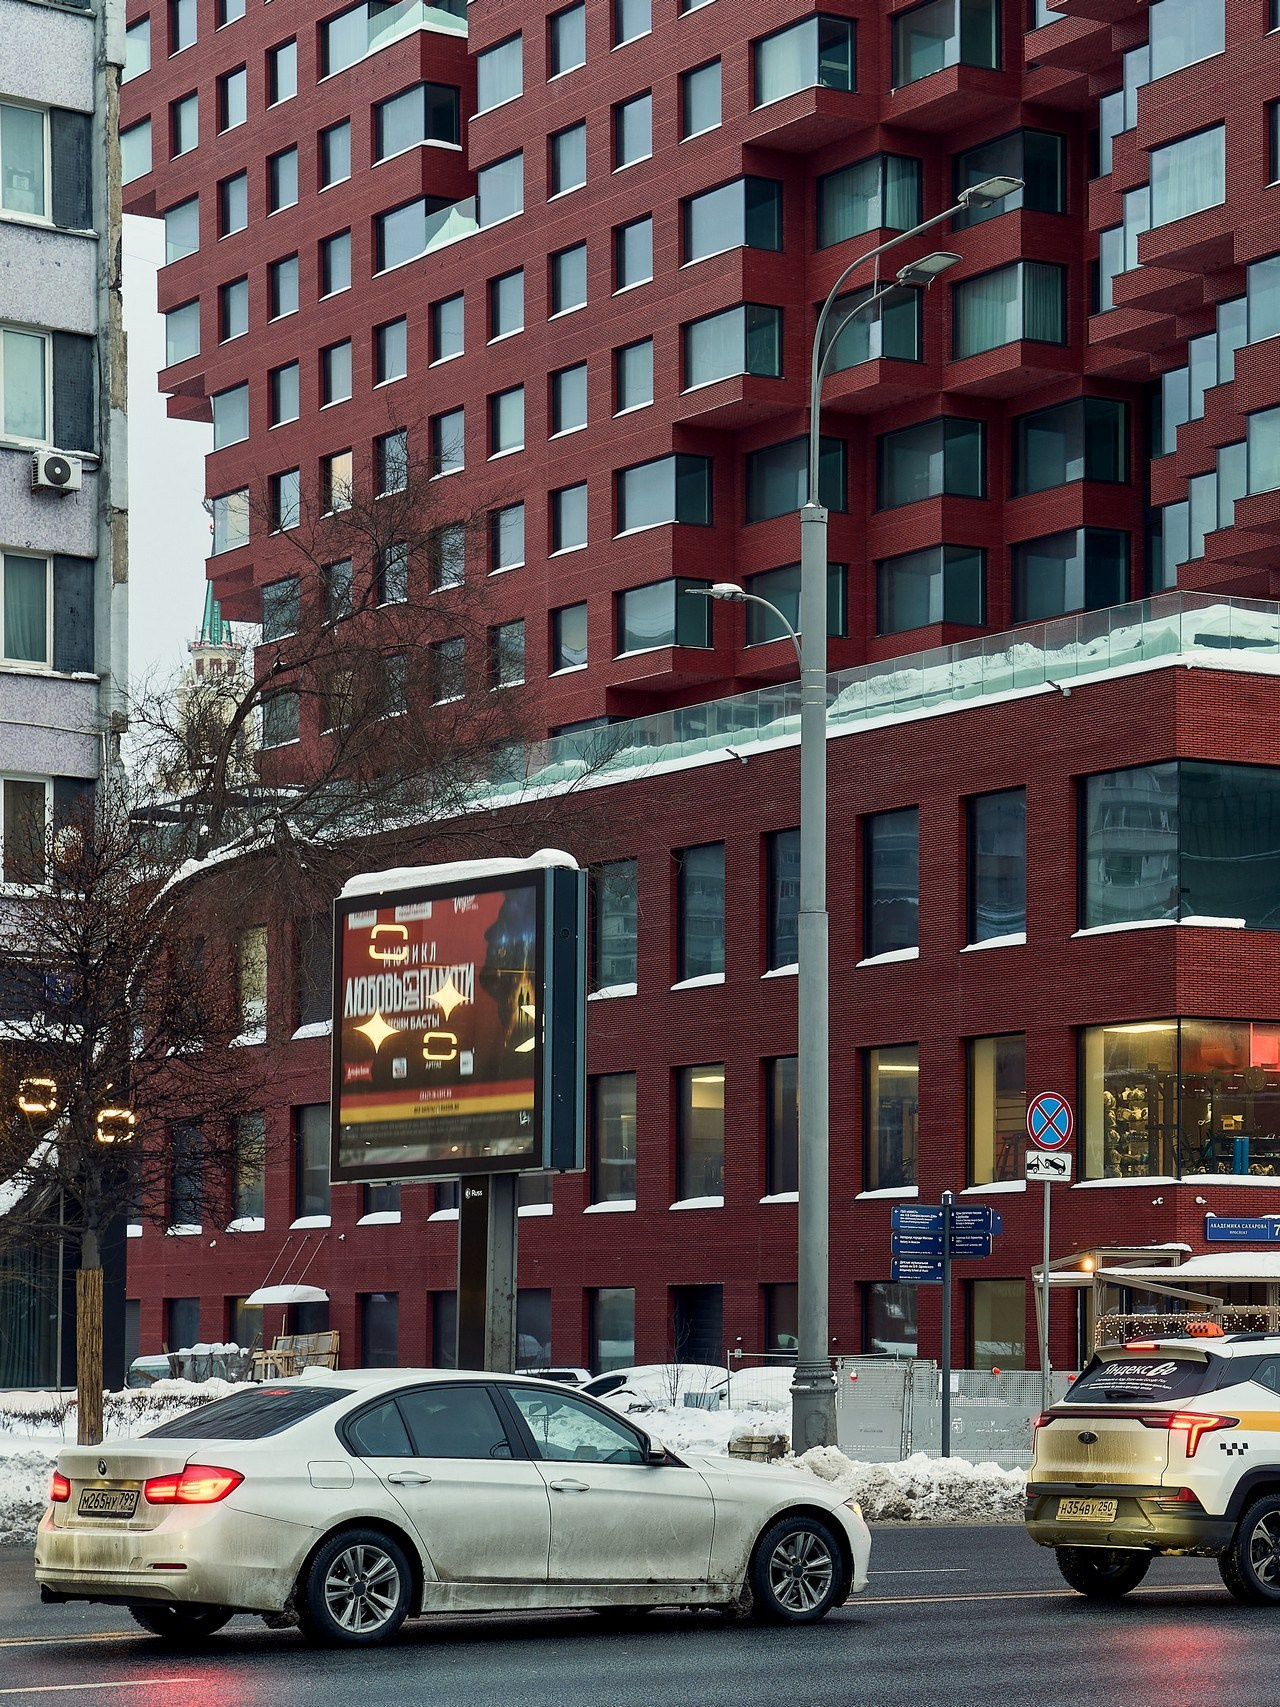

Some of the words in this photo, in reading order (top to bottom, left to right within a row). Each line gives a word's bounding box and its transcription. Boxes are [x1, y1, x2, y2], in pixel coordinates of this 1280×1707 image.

[344, 972, 403, 1018] ЛЮБОВЬ
[410, 1013, 440, 1031] БАСТЫ
[1273, 1224, 1280, 1236] 7
[1101, 1363, 1153, 1376] Яндекс
[1146, 1361, 1178, 1377] Go
[81, 1492, 118, 1510] М265НУ
[118, 1492, 135, 1507] 799
[1060, 1501, 1097, 1515] Н354ВУ
[1098, 1501, 1114, 1512] 250
